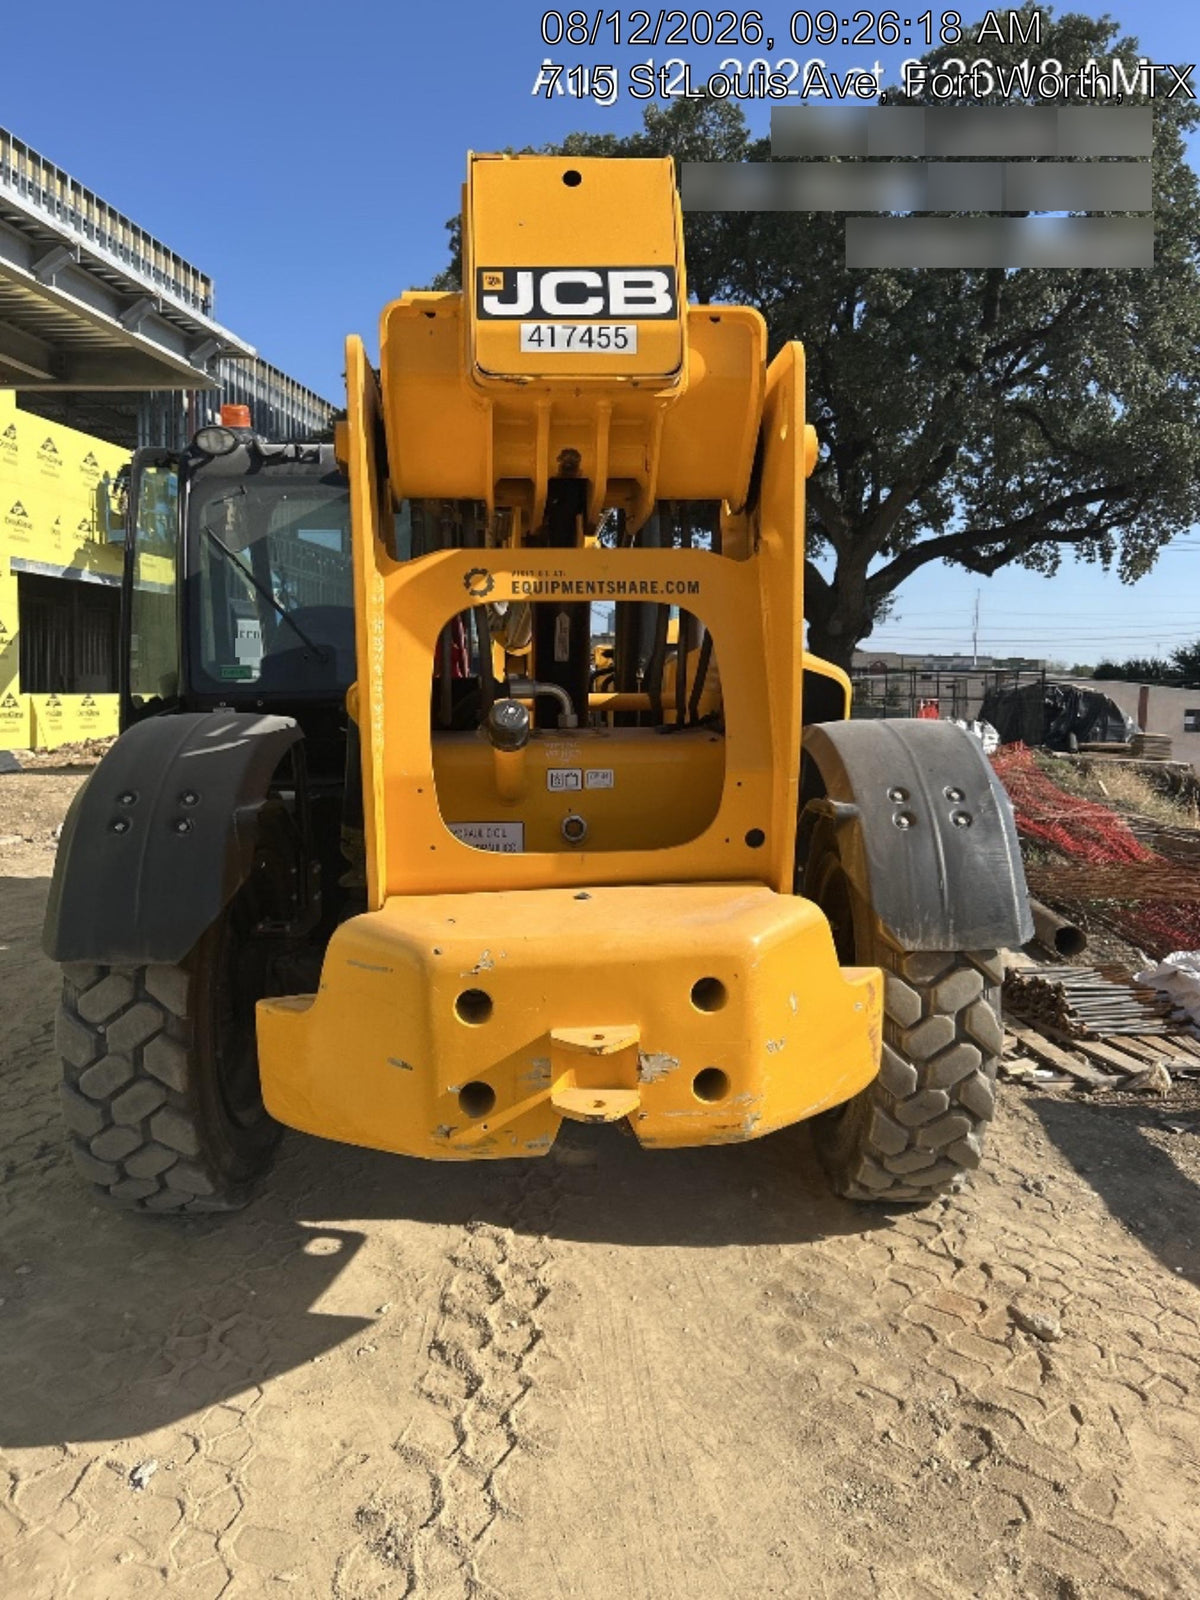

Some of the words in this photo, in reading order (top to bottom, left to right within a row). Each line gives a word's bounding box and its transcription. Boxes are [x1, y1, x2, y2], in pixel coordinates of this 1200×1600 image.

[482, 270, 674, 316] JCB
[528, 325, 629, 349] 417455
[511, 580, 700, 595] EQUIPMENTSHARE.COM
